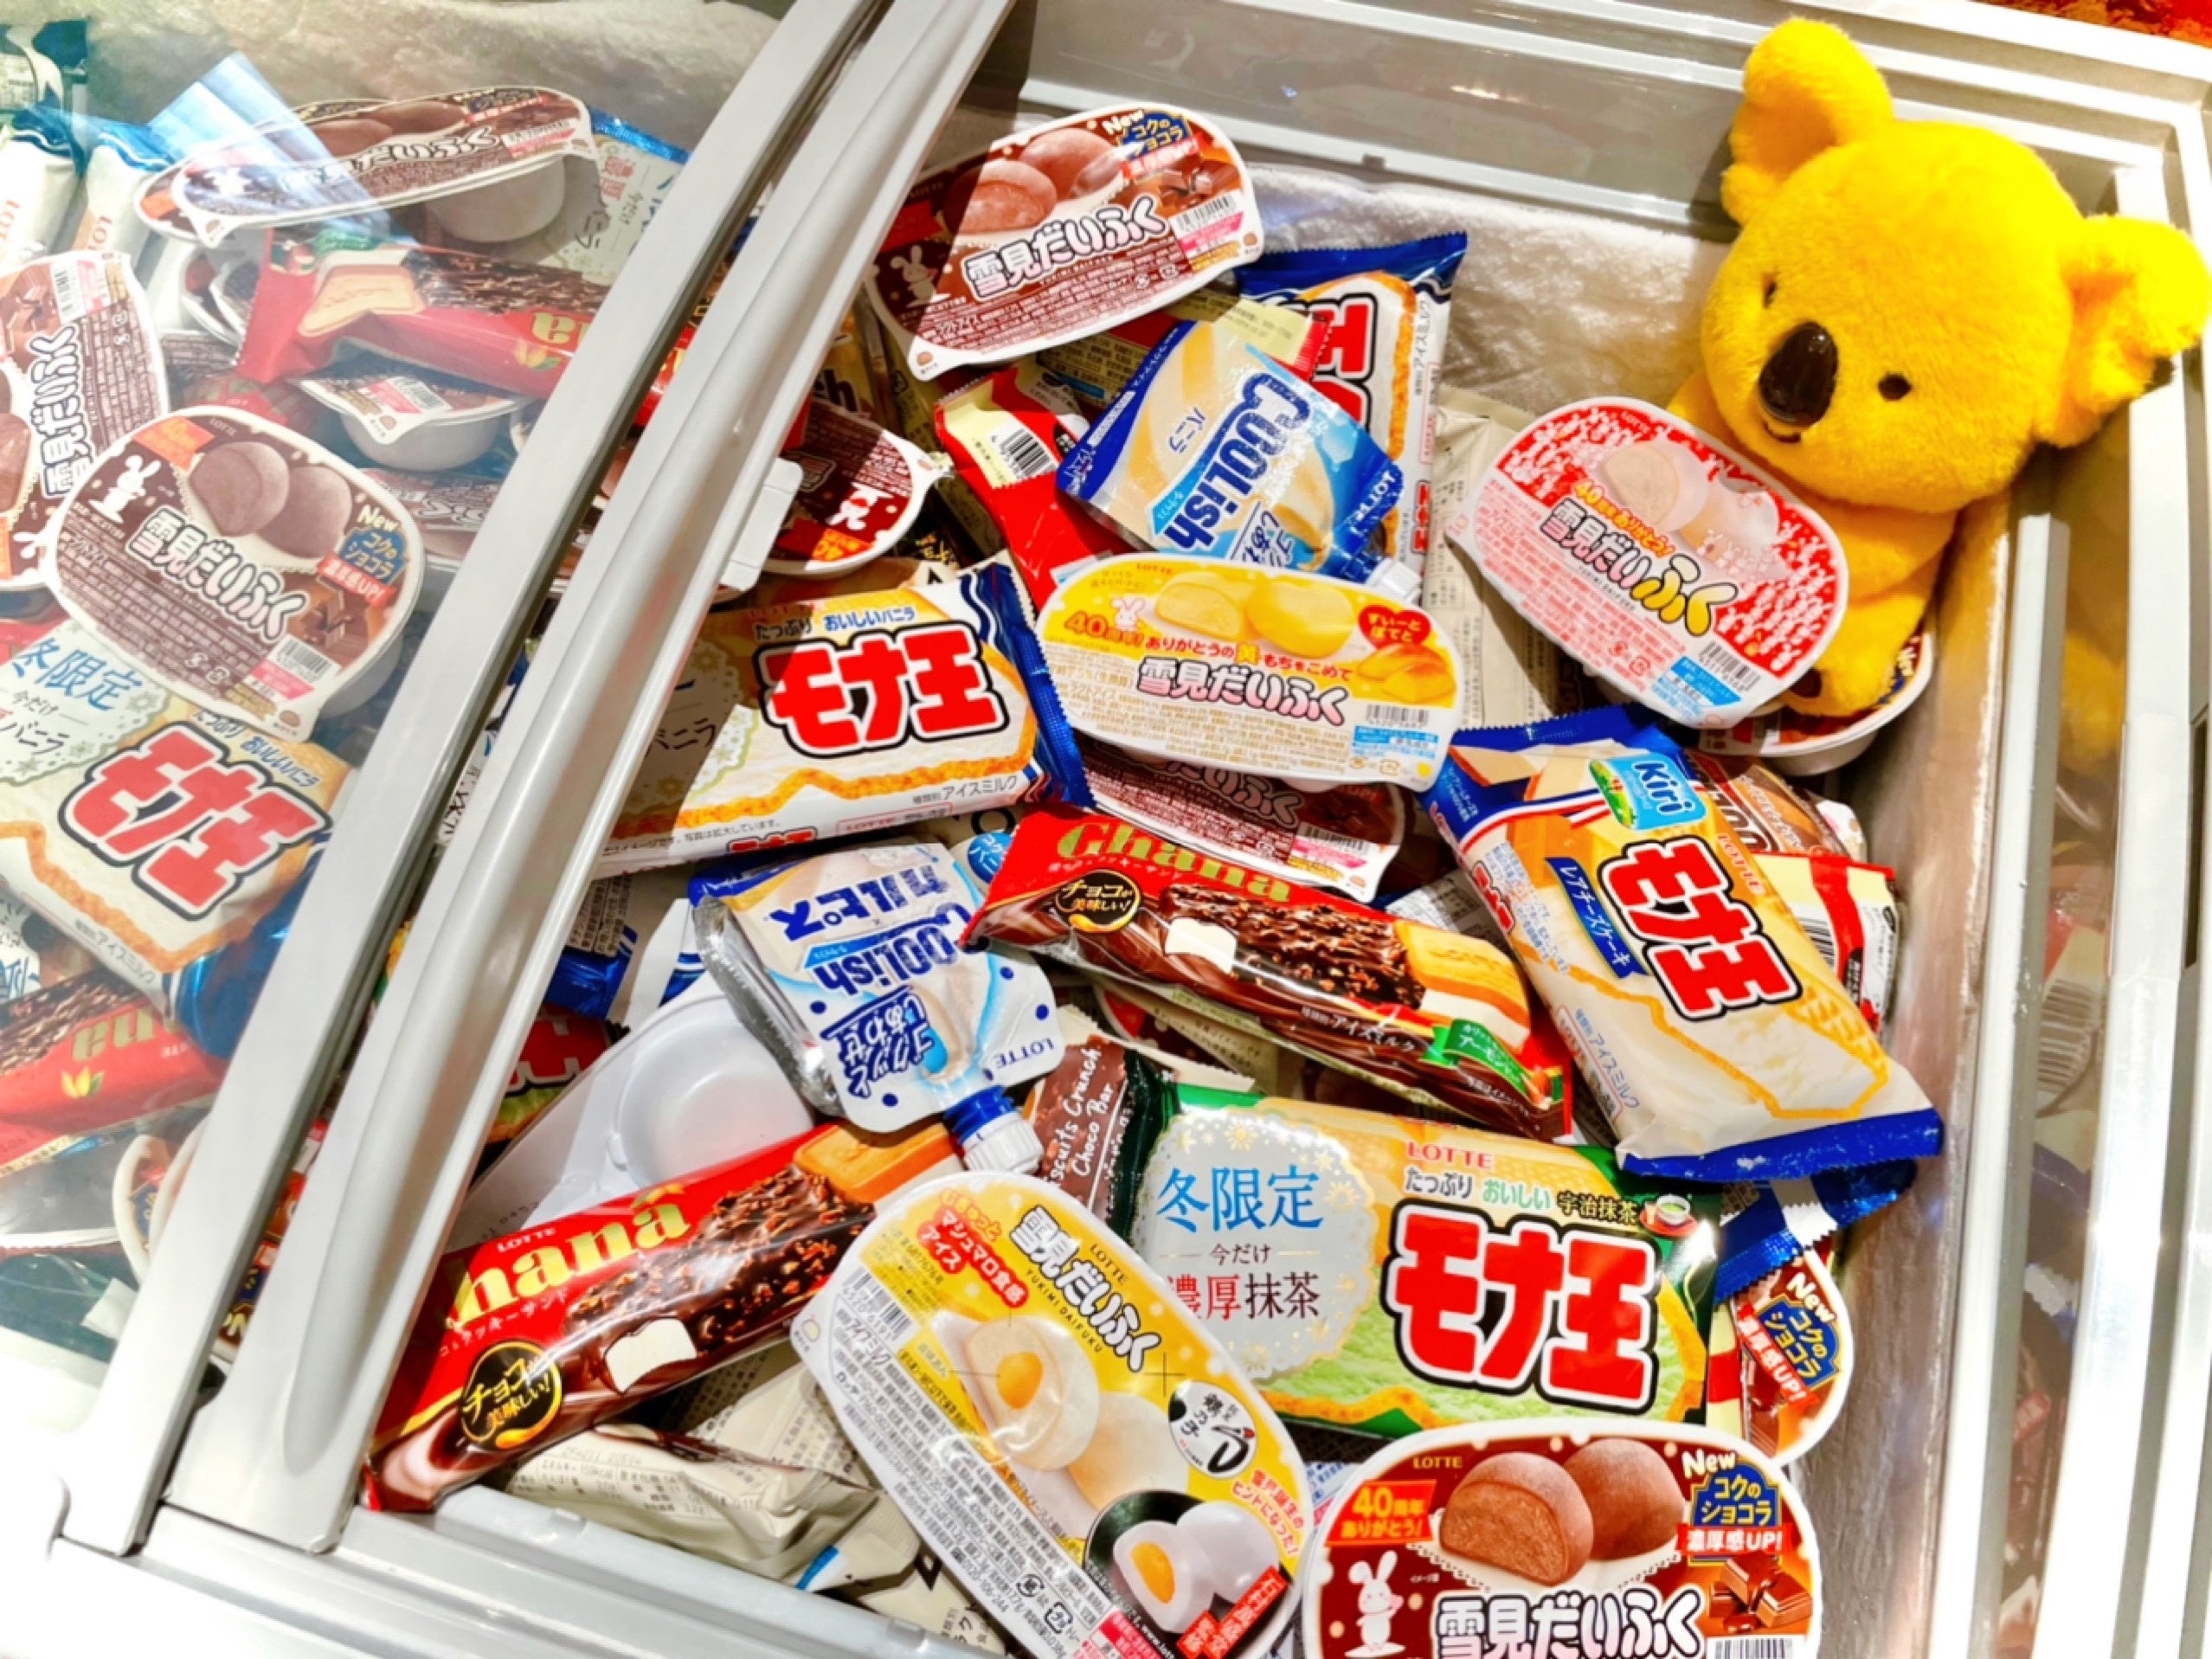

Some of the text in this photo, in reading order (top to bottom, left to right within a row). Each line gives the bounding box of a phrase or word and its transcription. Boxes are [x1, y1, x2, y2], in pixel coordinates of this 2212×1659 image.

[1102, 111, 1143, 135] New
[1132, 119, 1171, 139] コクの
[965, 197, 1165, 298] 雪見だいふく
[1168, 407, 1206, 453] バニラ
[1163, 372, 1311, 550] COOLish
[357, 504, 398, 533] New
[362, 530, 397, 559] コクの
[127, 507, 308, 640] 雪見だいふく
[1539, 498, 1738, 636] 雪見だいふく
[755, 607, 916, 640] たっぷり おいしいバニラ
[12, 636, 143, 712] 冬限定
[753, 621, 1010, 758] モナ王
[1138, 655, 1349, 725] 雪見だいふく
[13, 691, 59, 717] 今だけ
[942, 775, 1018, 800] アイスミルク
[1632, 761, 1693, 818] Kiri
[59, 720, 333, 922] モナ王
[1056, 822, 1291, 904] Ghana
[1717, 833, 1766, 895] LOTTE
[768, 865, 945, 942] カルピス
[1559, 864, 1631, 967] レアチーズケーキ
[1598, 837, 1803, 1019] モナ王
[839, 992, 929, 1066] しあわせ
[994, 1038, 1055, 1070] LOTTE
[1063, 1045, 1102, 1117] Crunch
[1590, 1032, 1639, 1108] アイスミルク
[1085, 1082, 1115, 1118] Bar
[1071, 1121, 1100, 1177] Choco
[1405, 1142, 1495, 1170] LOTTE
[1157, 1164, 1326, 1233] 冬限定
[1404, 1168, 1637, 1225] たっぷり おいしい 宇治抹茶
[446, 1203, 691, 1331] hana
[496, 1226, 556, 1253] LOTTE
[919, 1227, 964, 1274] アイス
[937, 1208, 1027, 1307] マシュマロ食感
[1088, 1241, 1129, 1285] LOTTE
[1209, 1243, 1271, 1265] 今だけ
[1008, 1204, 1163, 1373] 雪見だいふく
[1166, 1270, 1321, 1321] 濃厚抹茶
[1385, 1201, 1662, 1412] モナ王
[1786, 1272, 1835, 1322] New
[1764, 1311, 1823, 1379] ショコラ
[1788, 1309, 1828, 1359] コクの
[1412, 1457, 1463, 1469] LOTTE
[1682, 1450, 1736, 1479] New
[1714, 1479, 1760, 1500] コクの
[1341, 1518, 1424, 1541] ありがとう!
[1353, 1487, 1424, 1518] 40周年
[1701, 1501, 1772, 1525] ショコラ
[1687, 1529, 1783, 1553] 濃厚感UP!
[1435, 1585, 1705, 1659] 雪見だいふく
